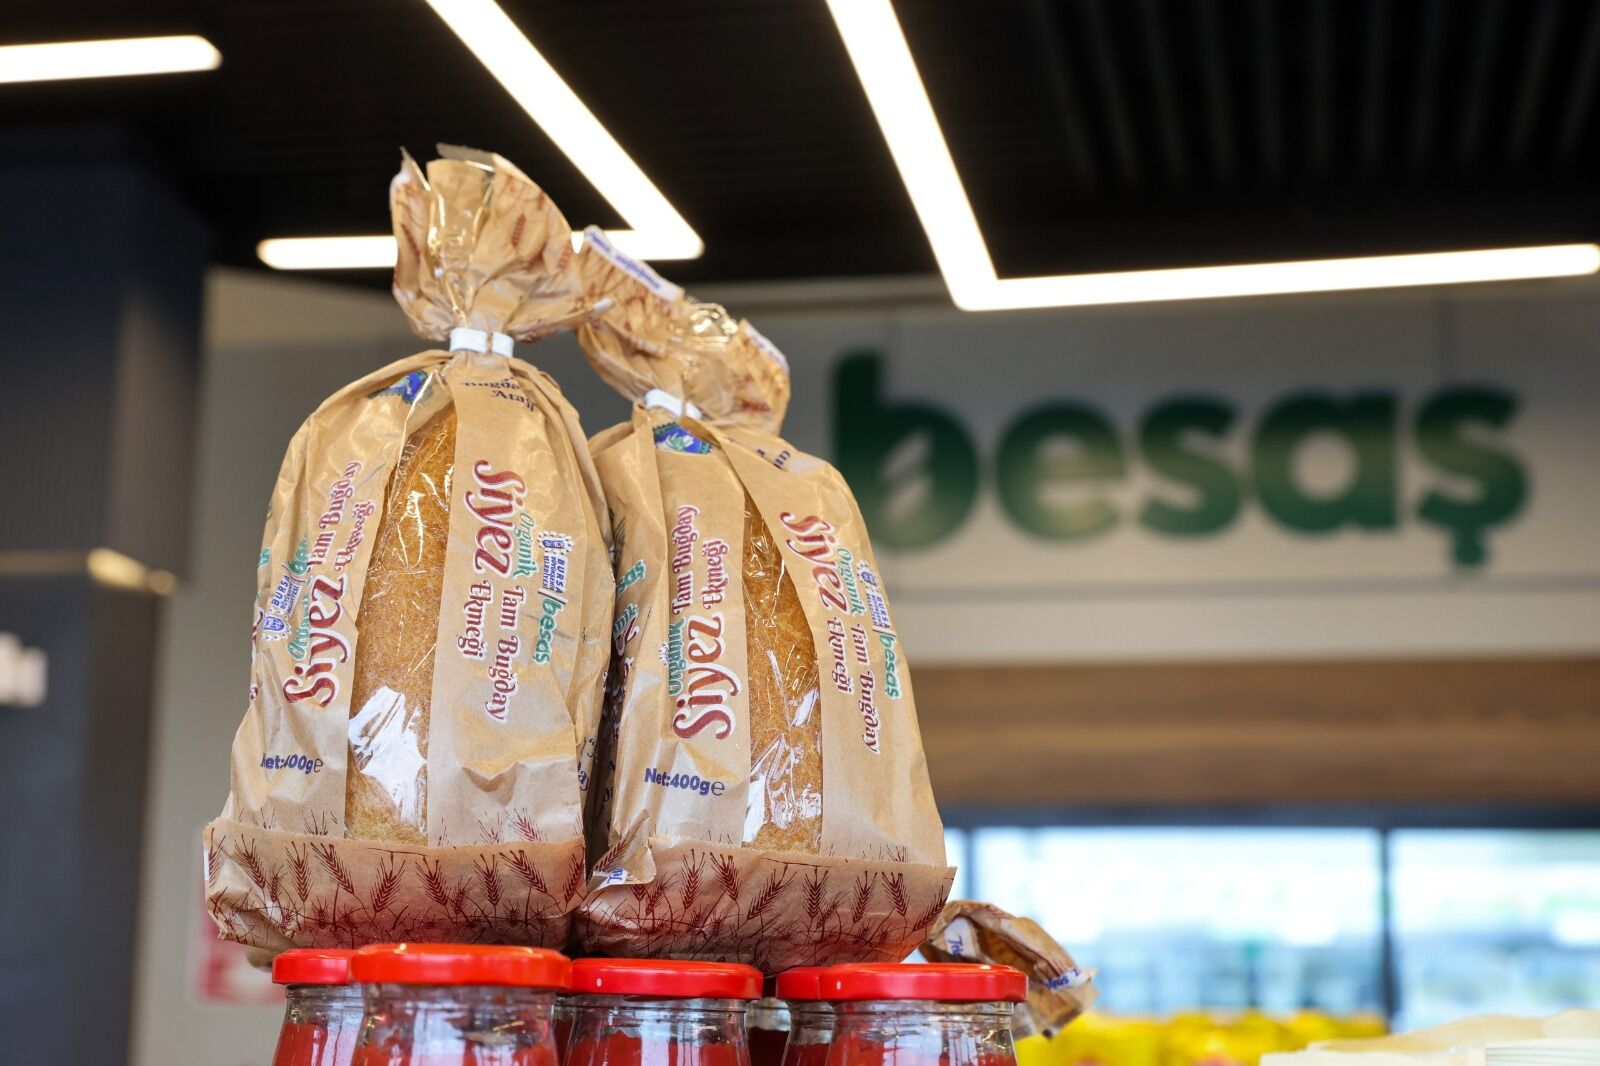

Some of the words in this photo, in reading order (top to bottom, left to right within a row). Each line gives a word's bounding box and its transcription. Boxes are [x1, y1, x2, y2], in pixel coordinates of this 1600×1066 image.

[828, 348, 1529, 568] besaş
[319, 462, 361, 529] Buğday
[466, 461, 525, 576] Siyez
[307, 532, 334, 572] Tam
[514, 514, 537, 577] Organik
[674, 506, 697, 573] Buğday
[781, 513, 846, 611] Siyez
[271, 574, 290, 606] BURSA
[500, 586, 524, 627] Tam
[555, 558, 566, 593] BURSA
[673, 572, 691, 614] Tam
[703, 540, 728, 608] Ekmeği
[839, 549, 865, 614] Organik
[284, 577, 347, 706] Siyez
[460, 580, 492, 657] Ekmeği
[532, 600, 562, 663] besaş
[876, 596, 891, 628] BURSA
[486, 635, 518, 720] Buğday
[674, 616, 738, 739] Siyez
[828, 618, 852, 693] Ekmeği
[852, 624, 867, 663] Tam
[860, 671, 878, 752] Buğday
[880, 634, 899, 697] besaş
